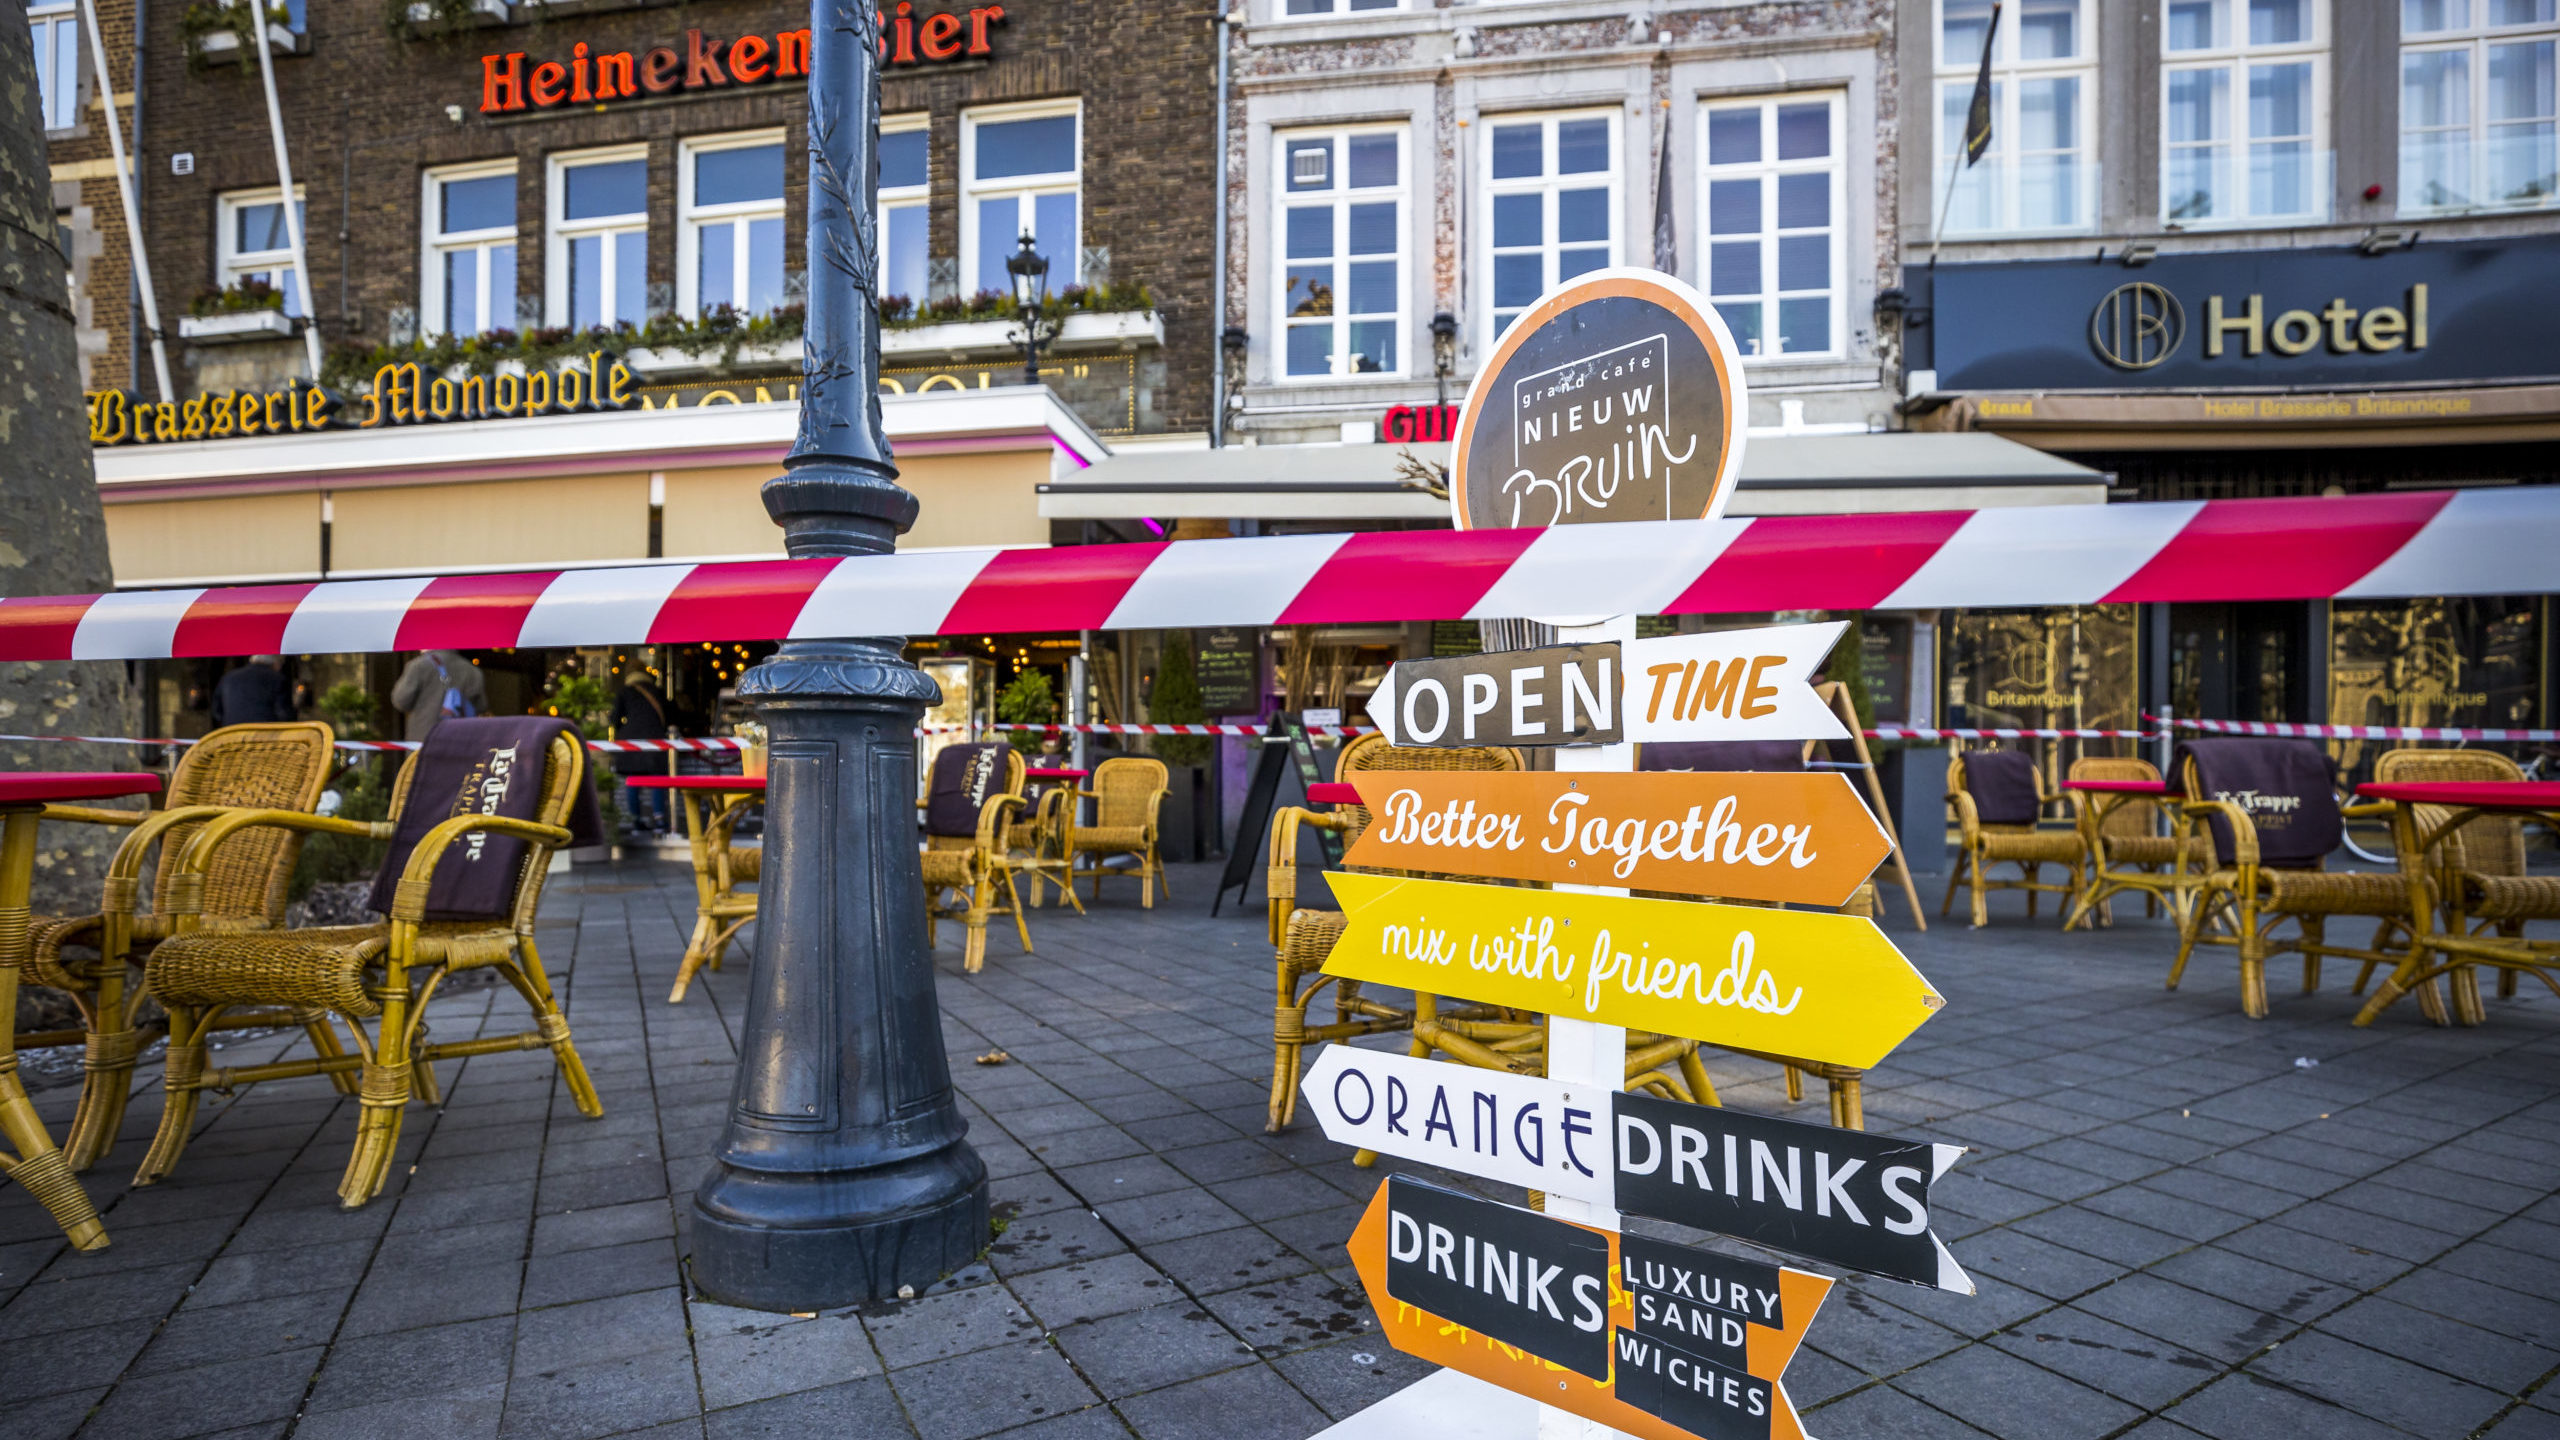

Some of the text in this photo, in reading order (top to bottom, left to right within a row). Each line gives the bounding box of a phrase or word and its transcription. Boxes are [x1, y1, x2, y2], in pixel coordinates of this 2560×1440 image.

[479, 3, 1005, 113] Heineken ier
[2207, 283, 2429, 356] Hotel
[87, 375, 330, 446] Brasserie
[360, 349, 632, 428] Monopole
[1522, 349, 1653, 409] grand café
[1523, 384, 1653, 445] NIEUW
[2204, 397, 2472, 417] Hotel Brasserie Britannique
[1403, 657, 1613, 744] OPEN
[1646, 655, 1788, 724] TIME
[1379, 788, 1525, 851] Better
[1541, 792, 1817, 879] Together
[1382, 916, 1804, 1017] mix with friends
[1333, 1067, 1930, 1236] ORANGE DRINKS
[1390, 1208, 1605, 1334] DRINKS
[1624, 1255, 1780, 1320] LUXURY
[1639, 1294, 1745, 1349] SAND
[1616, 1333, 1767, 1417] WICHES
